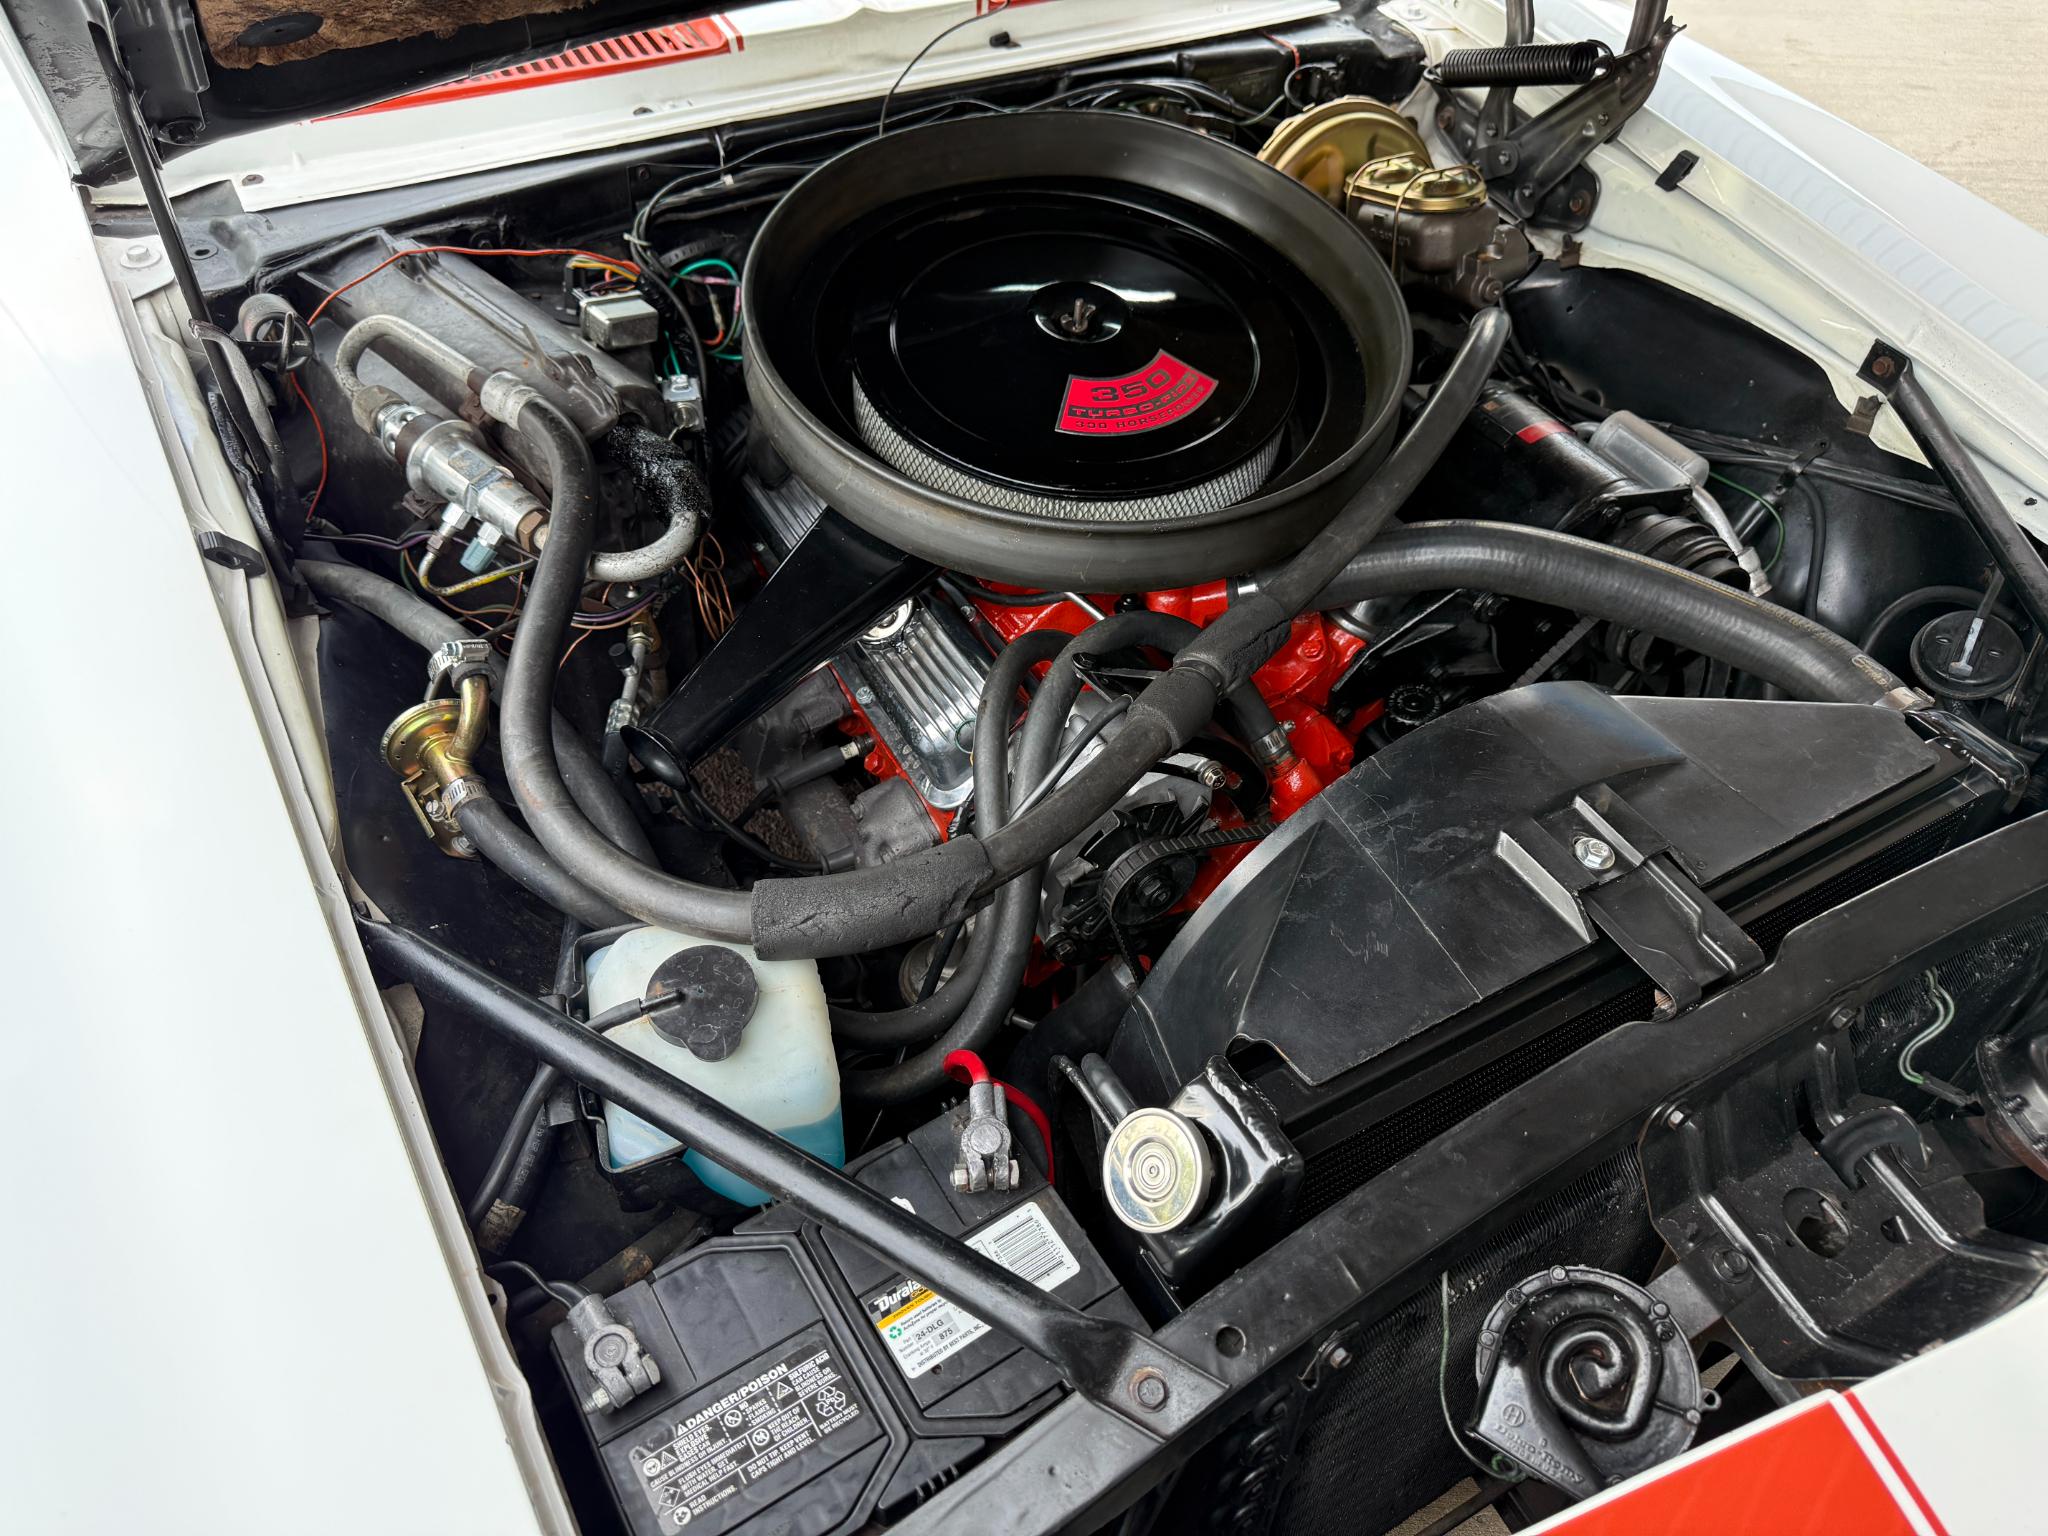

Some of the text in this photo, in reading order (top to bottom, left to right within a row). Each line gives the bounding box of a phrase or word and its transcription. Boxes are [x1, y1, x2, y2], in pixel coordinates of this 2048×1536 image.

[1090, 369, 1171, 402] 350
[1075, 385, 1205, 429] 300 HORSEPOWER
[874, 1278, 922, 1313] Durala
[915, 1319, 944, 1340] 24-DLG
[939, 1328, 953, 1340] 875
[788, 1352, 829, 1380] SULFURIC ACID
[792, 1367, 819, 1385] CAN CAUSE
[795, 1372, 822, 1391] BLINDNESS
[798, 1383, 817, 1397] SEVERE
[685, 1363, 788, 1428] DANGER/POISON
[739, 1401, 748, 1409] NO
[745, 1399, 766, 1413] SPARKS
[748, 1404, 769, 1419] FLAMES
[751, 1408, 776, 1425] SMOKING
[767, 1406, 800, 1429] KEEP OUT OF
[819, 1403, 857, 1429] BATTERY MUST
[832, 1409, 859, 1428] RECYCLED
[771, 1415, 799, 1435] THE REACH
[672, 1434, 694, 1449] SHIELD
[676, 1433, 708, 1456] EXPLOSIVE
[773, 1433, 782, 1441] OF
[678, 1439, 747, 1484] FLUSH EYES IMMEDIATELY
[679, 1440, 709, 1461] GASES CAN
[747, 1463, 756, 1471] DO
[756, 1455, 769, 1465] NOT
[779, 1440, 794, 1451] KEEP
[794, 1431, 809, 1442] VENT
[650, 1474, 668, 1487] CAUSE
[668, 1455, 697, 1476] BLINDNESS
[698, 1450, 706, 1458] OR
[750, 1465, 766, 1478] CAPS
[766, 1455, 784, 1468] TIGHT
[783, 1447, 796, 1458] AND
[681, 1478, 696, 1490] WITH
[717, 1459, 728, 1468] GET
[684, 1479, 708, 1496] MEDICAL
[709, 1470, 723, 1481] HELP
[688, 1494, 706, 1508] READ
[692, 1484, 737, 1515] INSTRUCTIONS.
